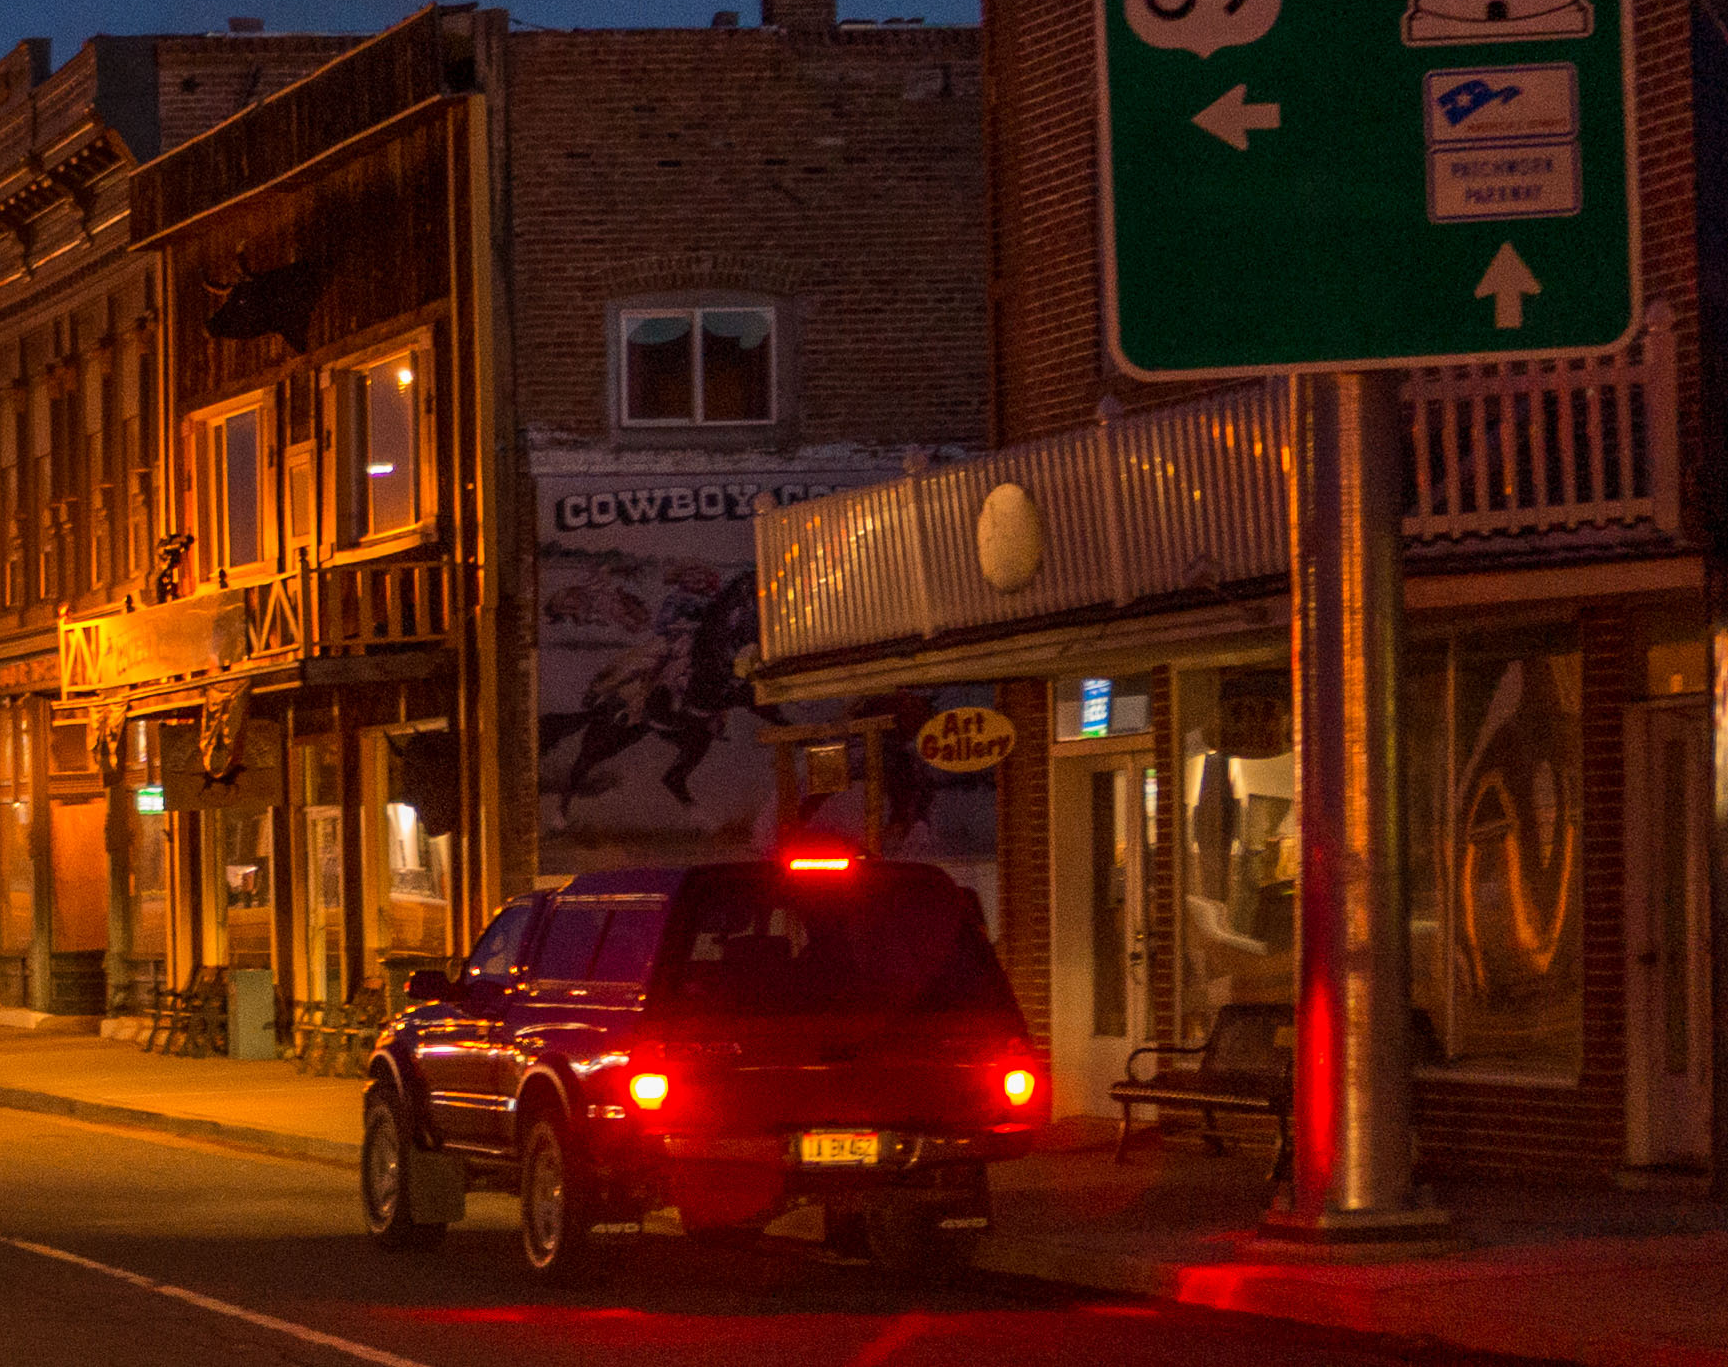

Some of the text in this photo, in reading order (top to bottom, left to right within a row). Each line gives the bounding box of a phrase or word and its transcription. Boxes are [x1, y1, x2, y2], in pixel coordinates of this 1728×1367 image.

[557, 484, 758, 530] COWBOY
[943, 712, 985, 738] Art
[922, 734, 1011, 761] Gallery
